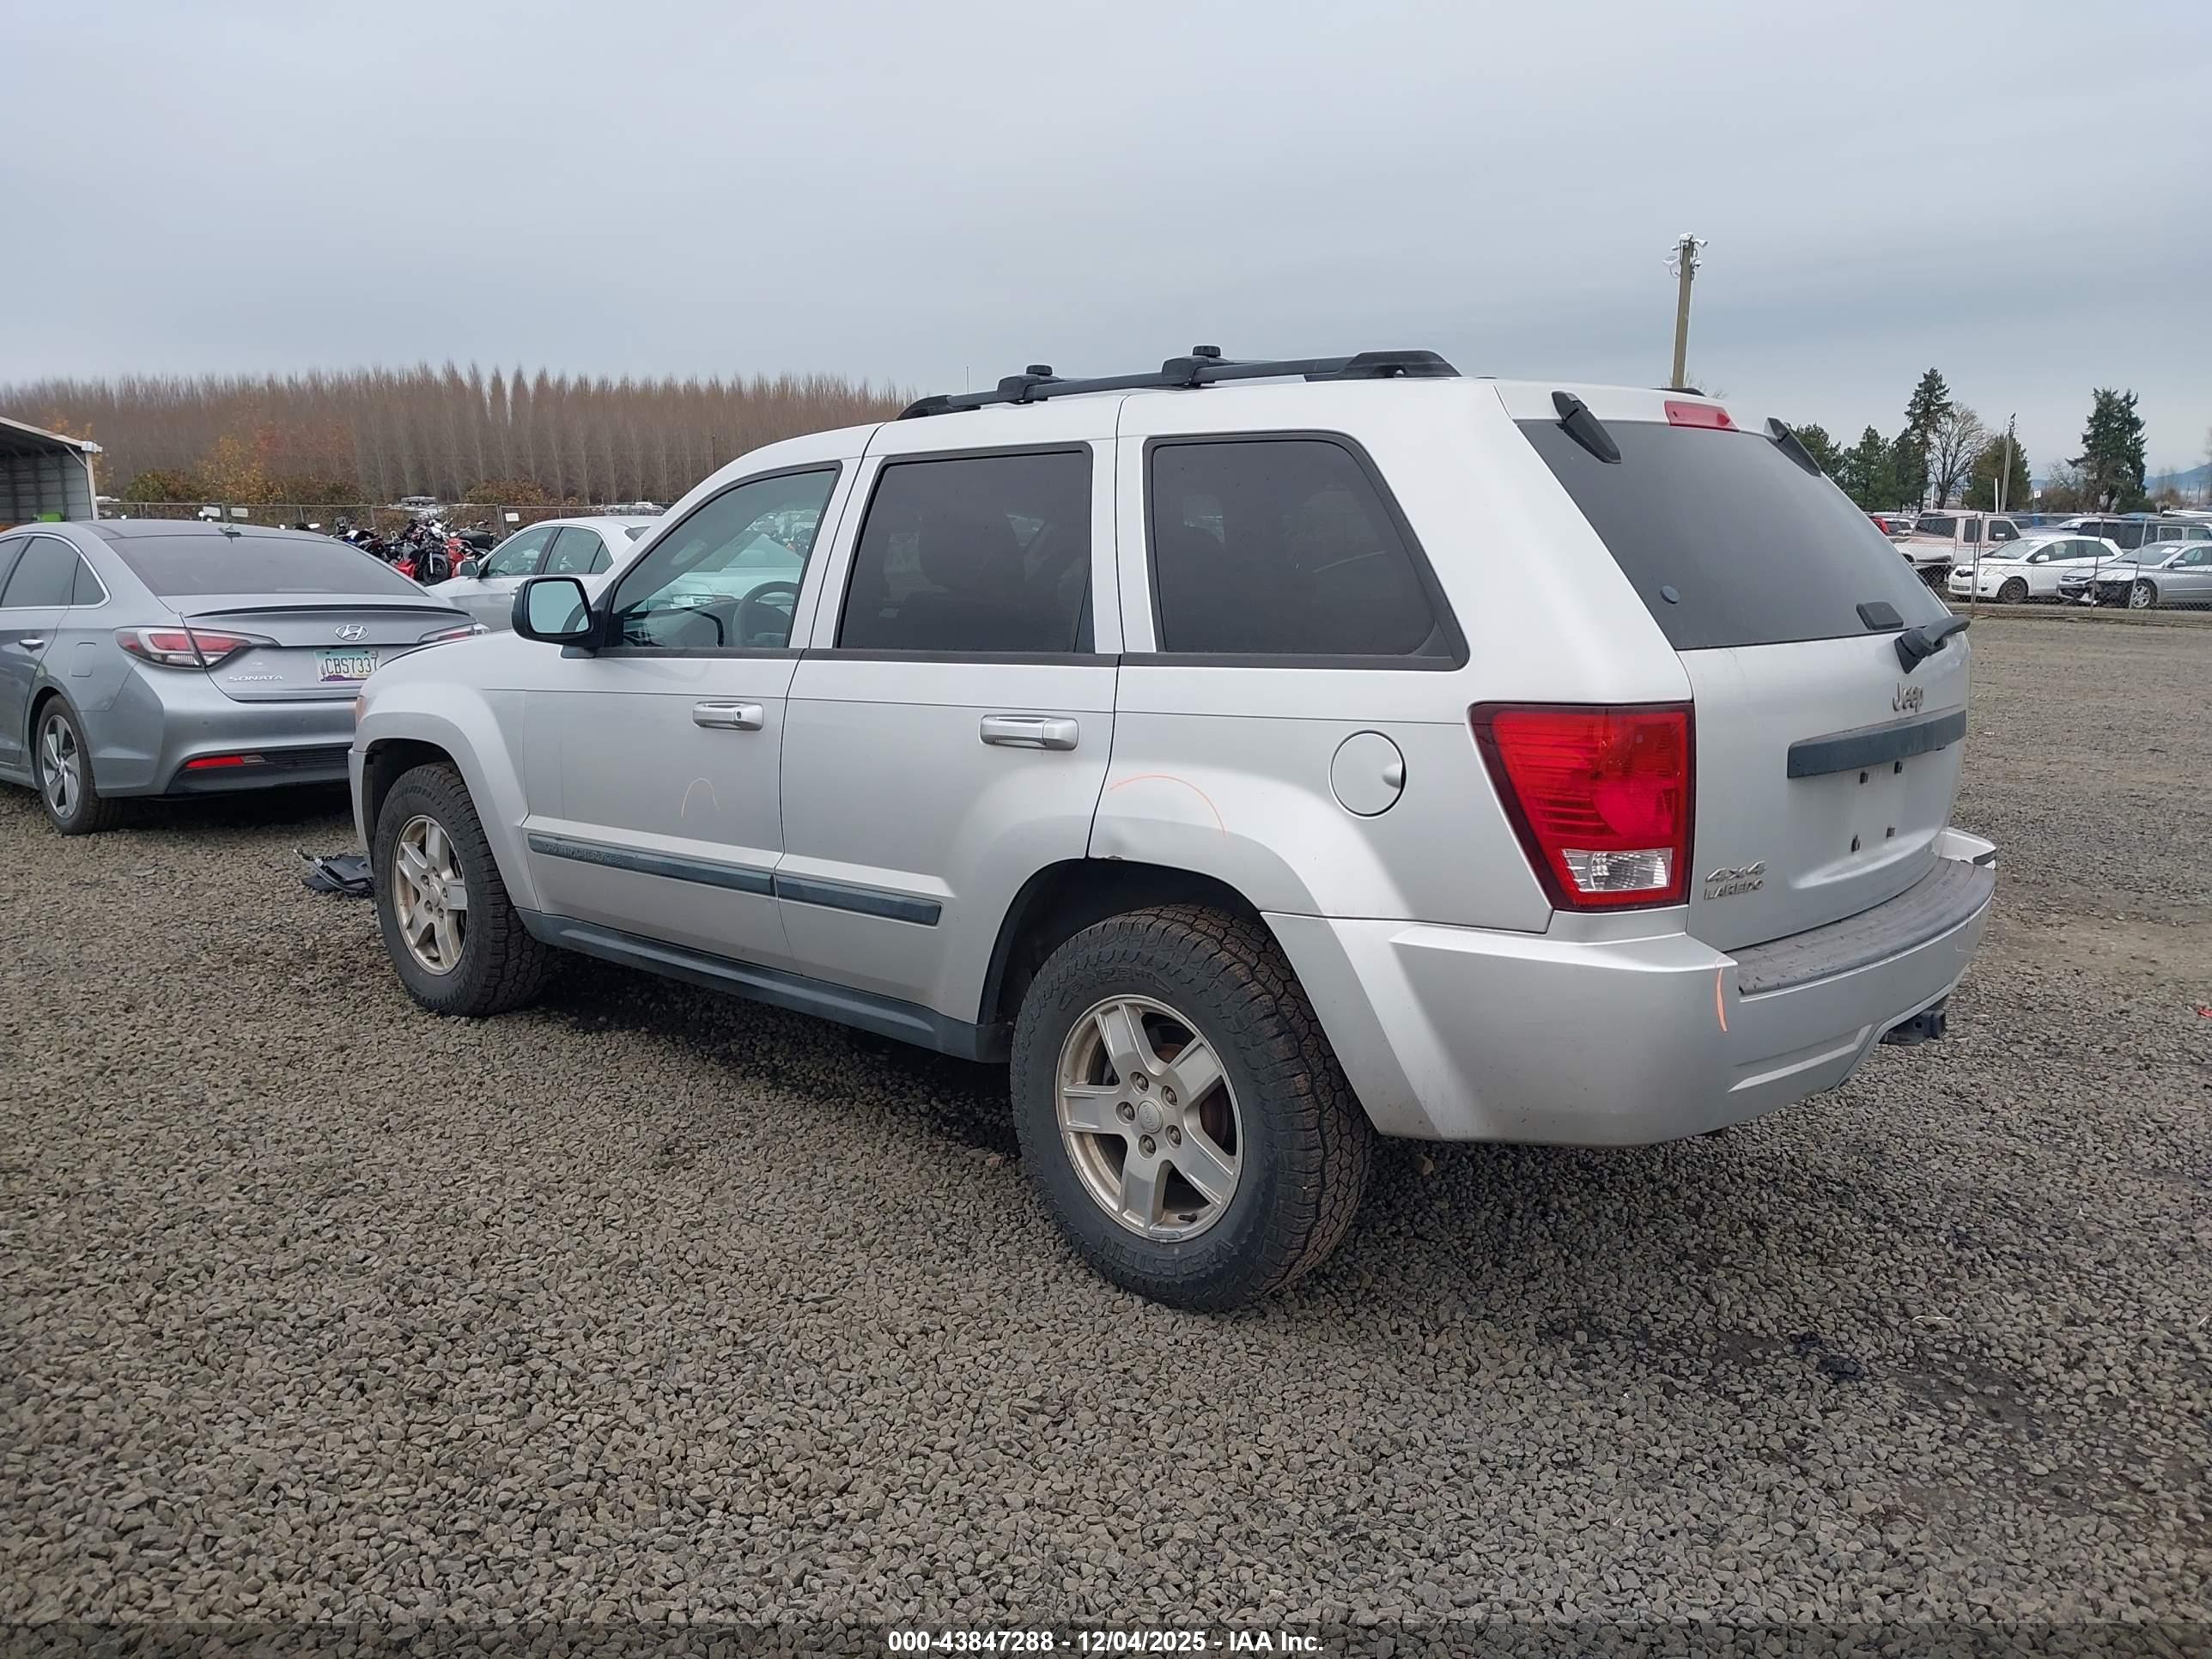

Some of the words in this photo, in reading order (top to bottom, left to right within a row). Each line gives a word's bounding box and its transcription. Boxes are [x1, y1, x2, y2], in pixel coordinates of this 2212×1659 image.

[325, 657, 379, 674] CBS7337
[1892, 682, 1923, 714] Jeep
[1705, 860, 1765, 883] 4x4
[1704, 879, 1764, 900] LAREDO
